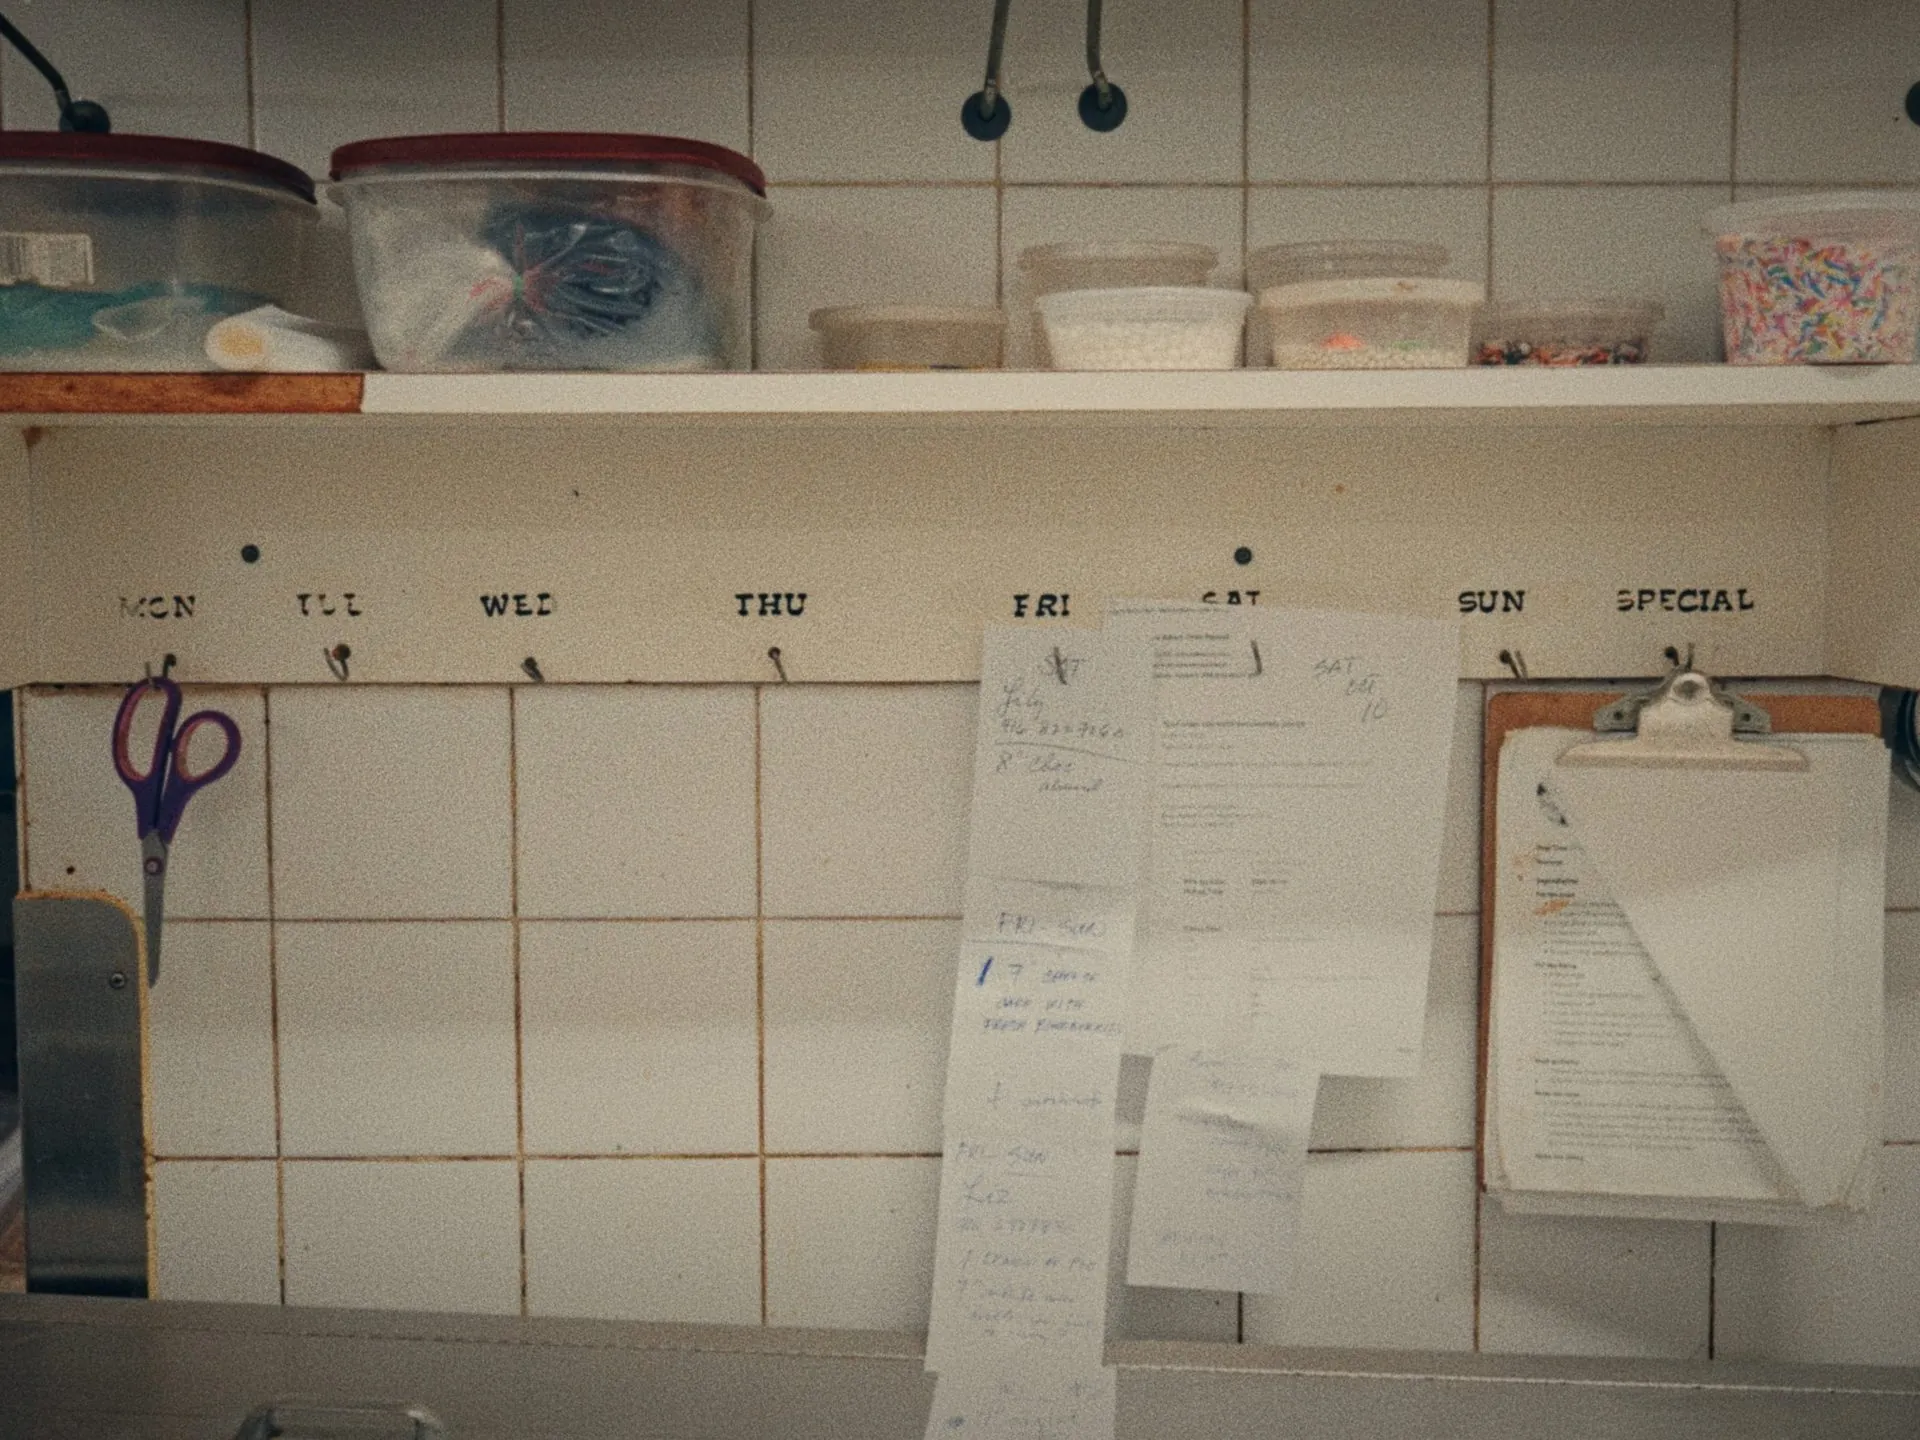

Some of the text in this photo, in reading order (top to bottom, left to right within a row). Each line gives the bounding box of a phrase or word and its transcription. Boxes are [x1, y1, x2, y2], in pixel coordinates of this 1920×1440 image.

[480, 593, 557, 618] WED
[734, 592, 808, 617] THU
[1012, 593, 1071, 618] FRI
[1457, 589, 1527, 614] SUN
[1616, 587, 1755, 613] SPECIAL
